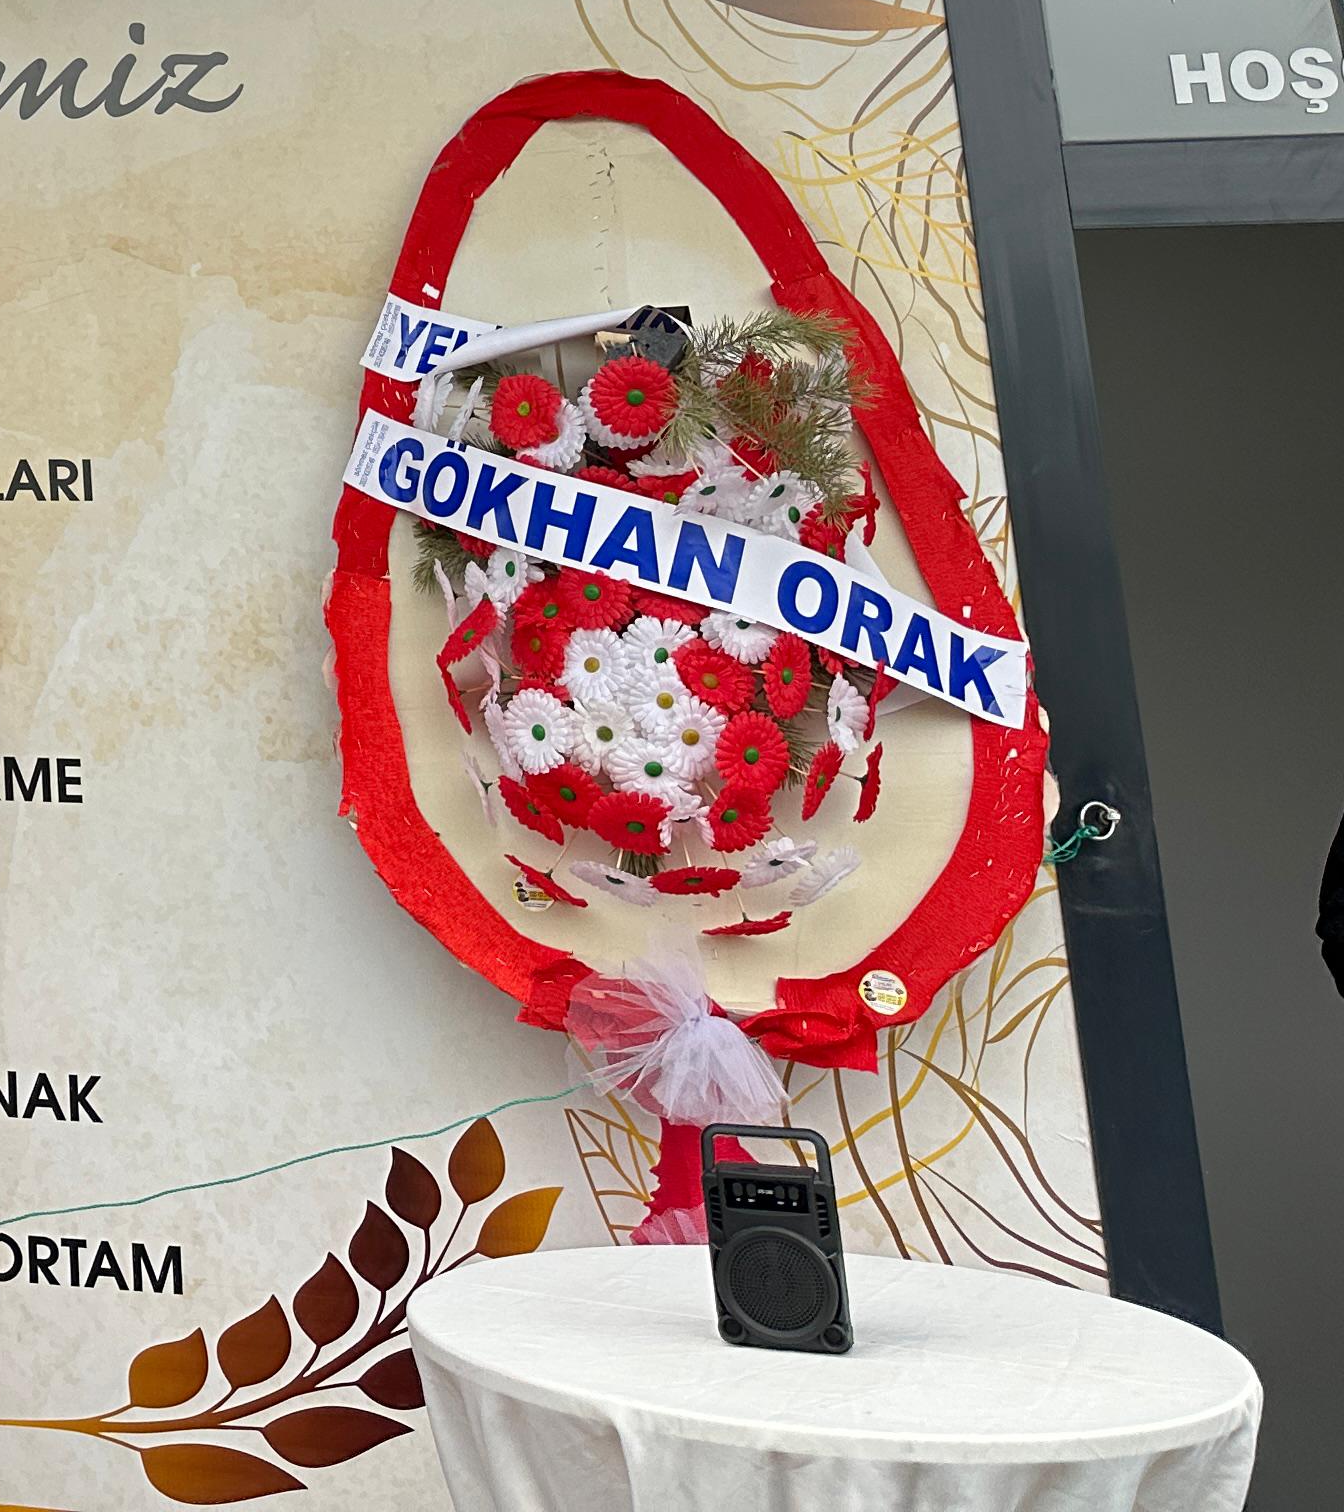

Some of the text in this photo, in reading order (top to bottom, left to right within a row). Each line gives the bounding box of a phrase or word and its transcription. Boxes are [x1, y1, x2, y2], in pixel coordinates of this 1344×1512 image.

[1168, 46, 1344, 114] HOŞ
[378, 436, 1008, 719] GÖKHAN ORAK
